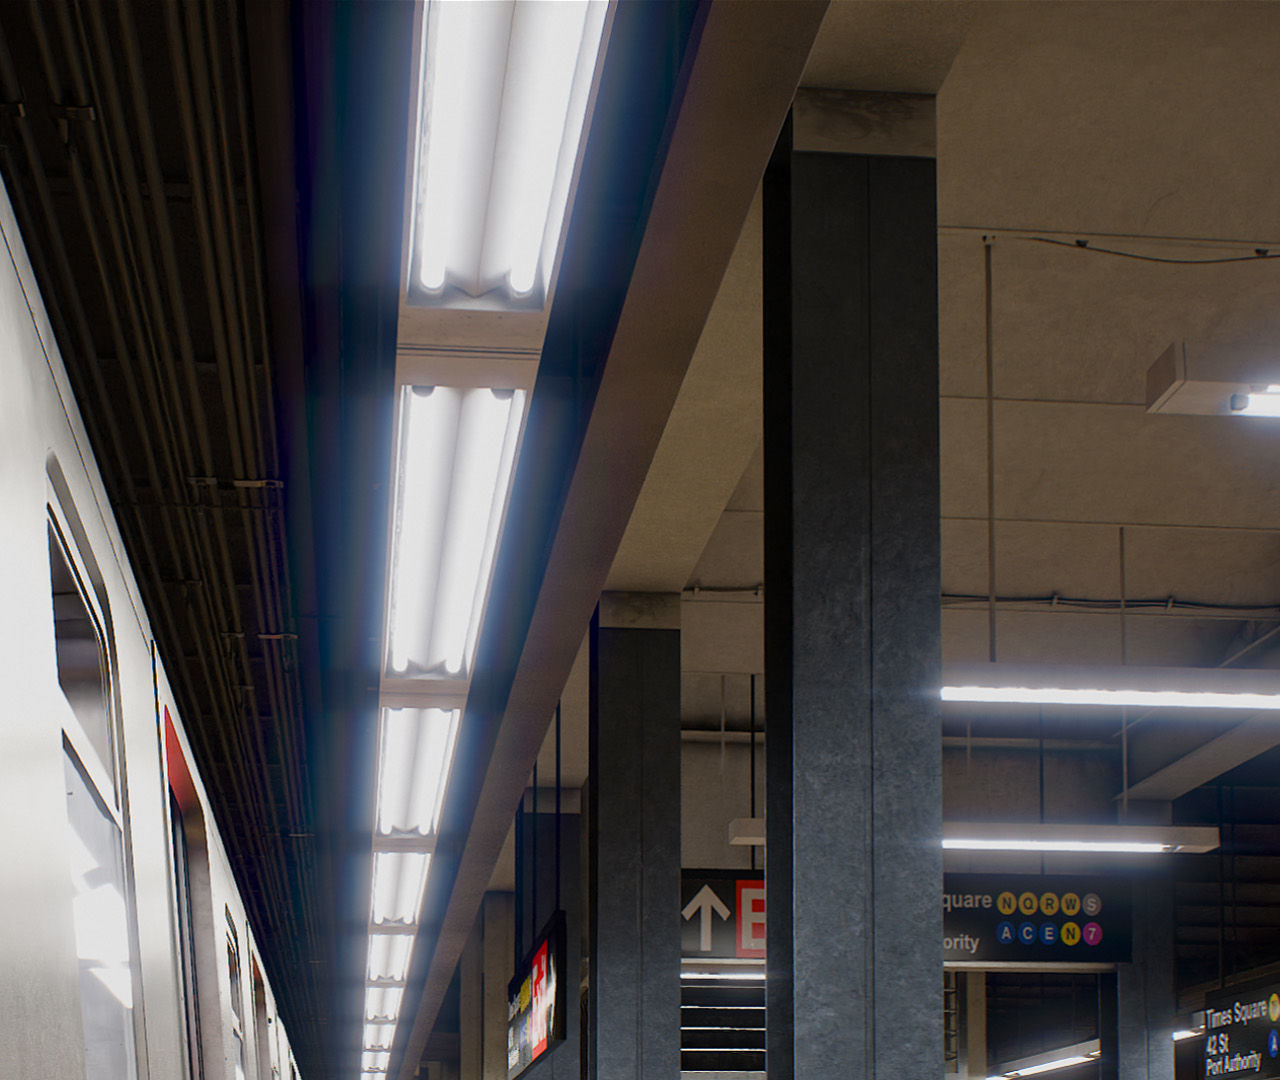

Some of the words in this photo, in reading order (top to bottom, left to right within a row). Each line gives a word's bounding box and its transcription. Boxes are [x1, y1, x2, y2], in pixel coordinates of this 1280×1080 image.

[943, 894, 993, 912] quare
[943, 934, 980, 954] ority
[1206, 1008, 1233, 1029] Times
[1233, 1001, 1268, 1026] Square
[1206, 1035, 1218, 1056] 42
[1218, 1033, 1229, 1054] St
[1206, 1057, 1224, 1076] Port
[1224, 1050, 1262, 1073] Authority
